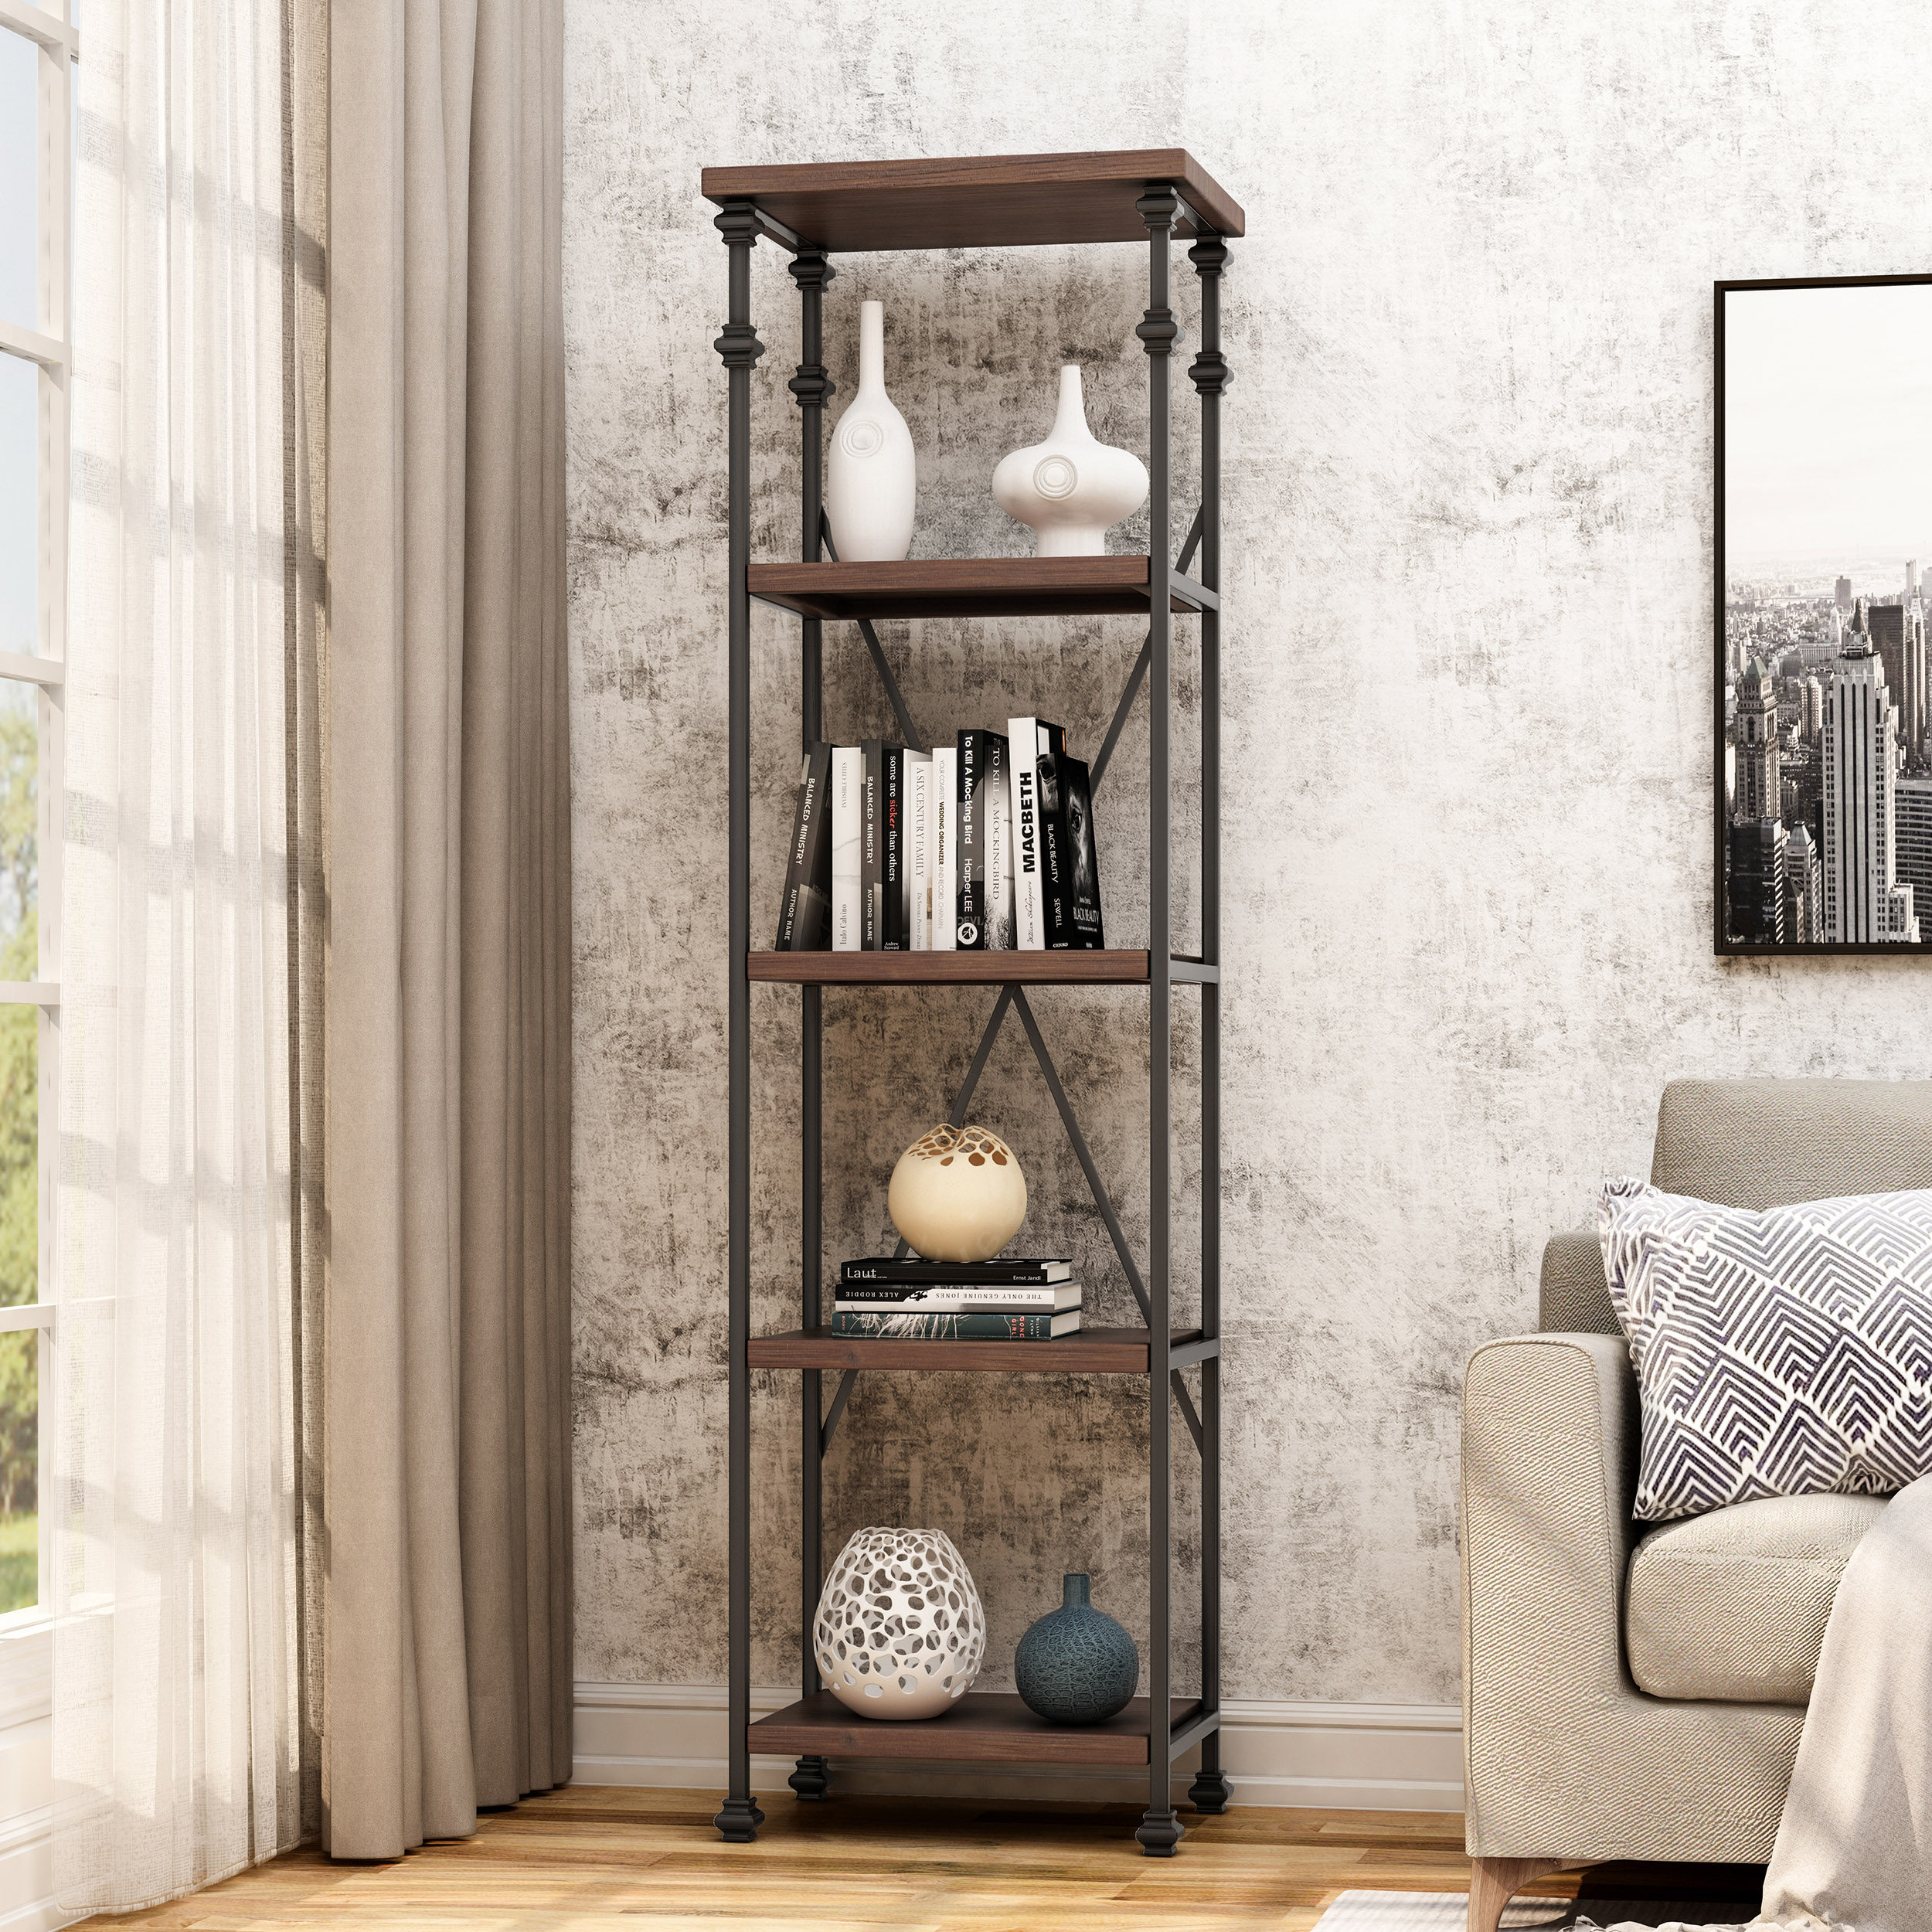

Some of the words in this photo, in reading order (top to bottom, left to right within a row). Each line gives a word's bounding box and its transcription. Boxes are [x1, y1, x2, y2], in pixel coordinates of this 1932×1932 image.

[964, 736, 973, 748] To
[964, 750, 973, 765] Kill
[992, 747, 1000, 766] TO
[916, 775, 925, 791] SIX
[964, 767, 973, 776] A
[803, 777, 815, 821] BALANCED
[963, 777, 973, 822] Mocking
[889, 799, 898, 829] sicker
[916, 792, 925, 840] CENTURY
[1019, 772, 1036, 873] MACBETH
[795, 824, 808, 865] MINISTRY
[889, 831, 897, 851] than
[964, 825, 973, 845] Bird
[1047, 824, 1056, 850] BLACK
[889, 852, 897, 882] others
[916, 841, 924, 878] FAMILY
[1049, 851, 1059, 883] BEAUTY
[962, 859, 973, 893] Harper
[787, 889, 798, 917] AUTHOR
[839, 903, 848, 928] Calvino
[964, 896, 973, 912] LEE
[1053, 897, 1063, 928] SEWELL
[784, 920, 792, 940] NAME
[839, 930, 848, 945] Italo
[847, 1267, 877, 1279] Laut
